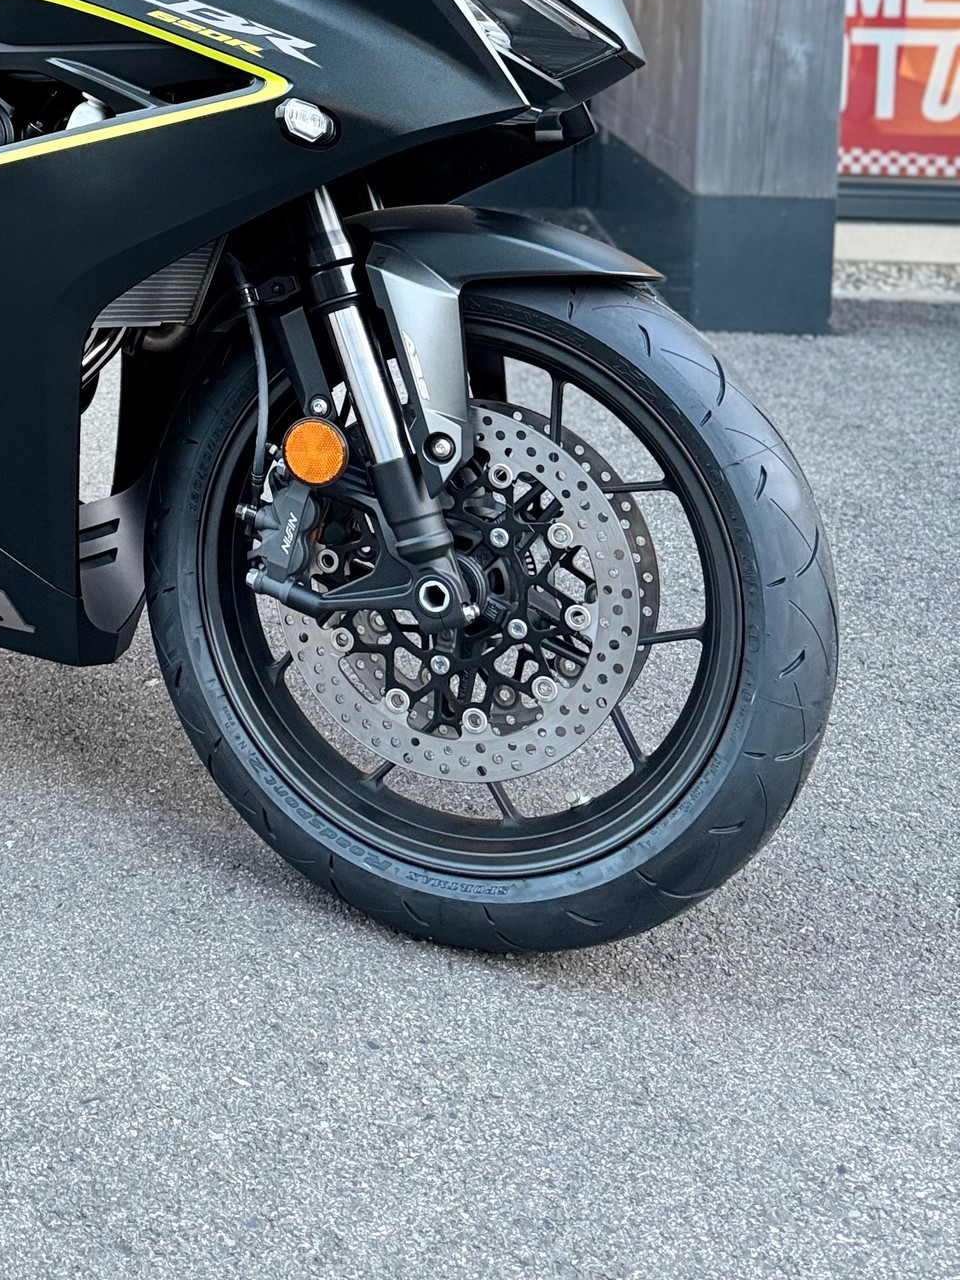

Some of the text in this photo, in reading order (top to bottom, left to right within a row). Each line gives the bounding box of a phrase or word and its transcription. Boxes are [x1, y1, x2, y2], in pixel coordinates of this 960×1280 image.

[147, 10, 265, 59] 650R
[281, 511, 298, 555] NISSIN
[264, 773, 393, 873] Roadsport
[405, 870, 511, 897] SPORTMAX
